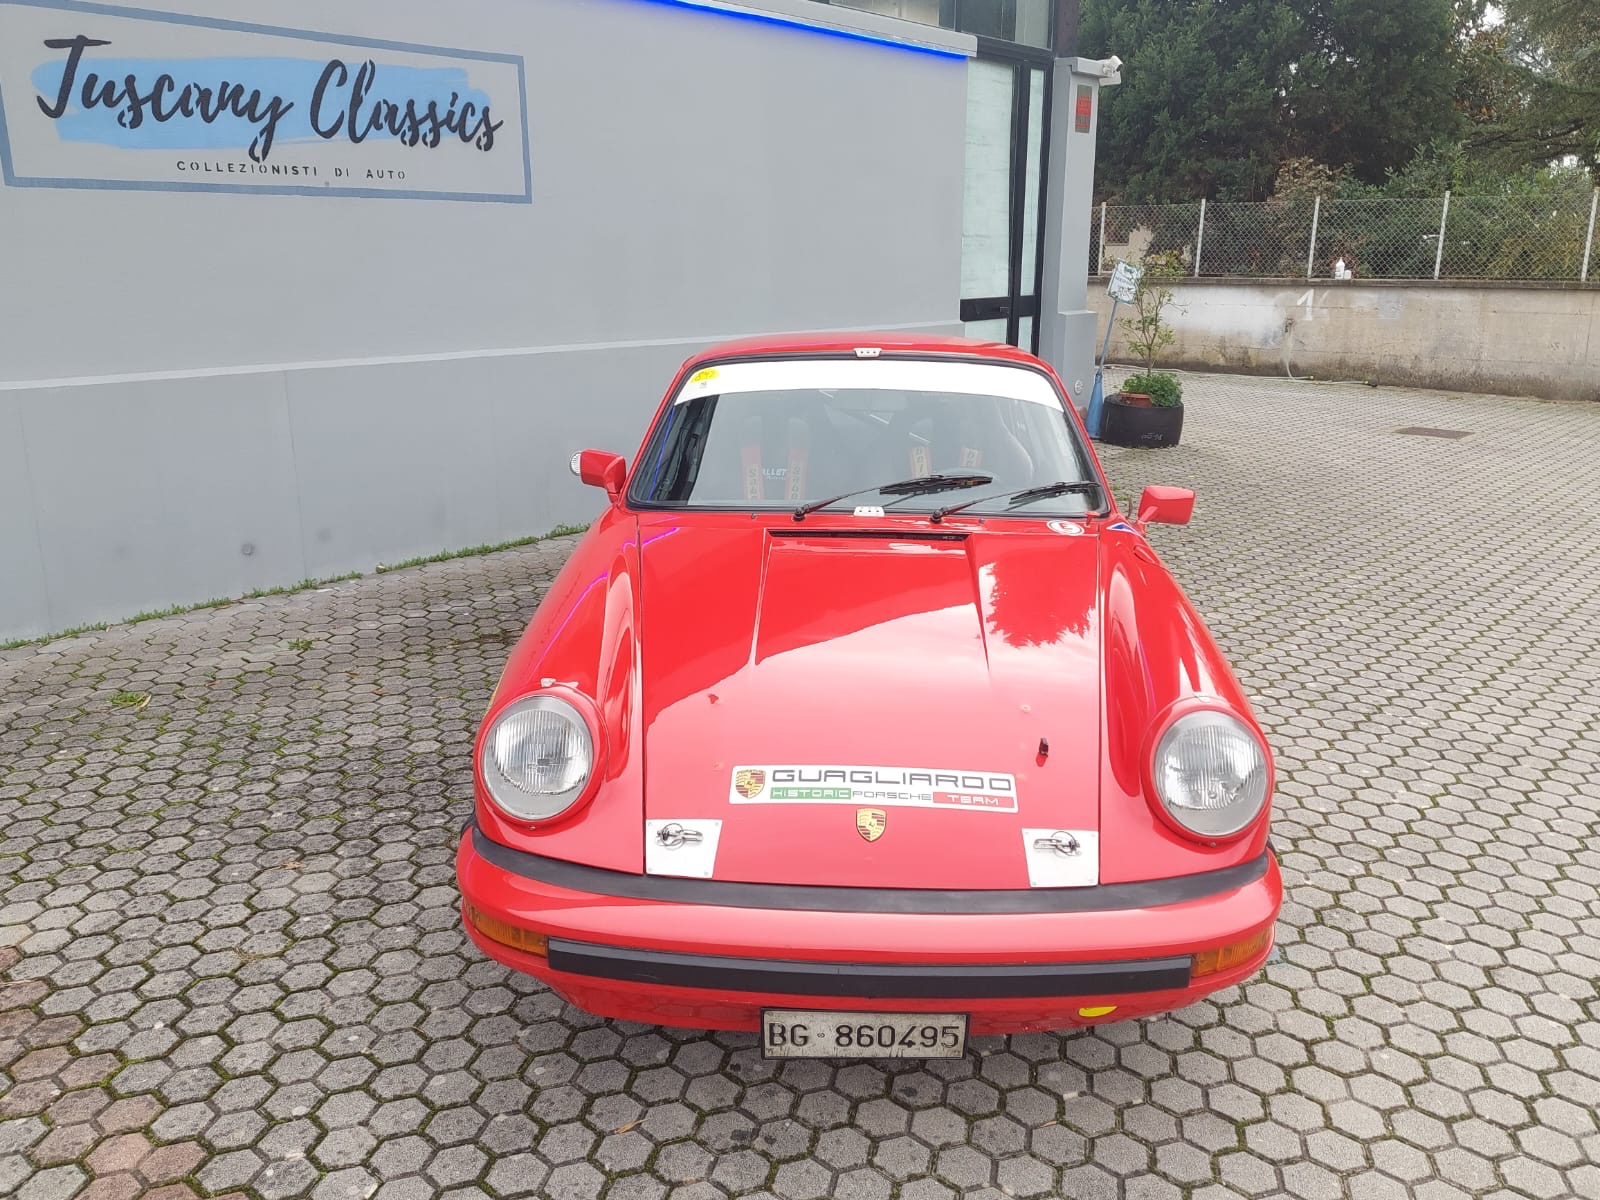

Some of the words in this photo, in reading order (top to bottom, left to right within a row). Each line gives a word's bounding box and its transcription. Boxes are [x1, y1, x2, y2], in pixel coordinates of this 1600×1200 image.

[36, 34, 295, 163] Tuscany
[309, 58, 504, 152] Classics
[176, 160, 318, 177] COLLEZIONISTI
[334, 167, 349, 177] DI
[366, 168, 406, 180] AUTO
[771, 769, 1012, 791] GUAGLIARDO
[772, 788, 850, 799] HISTORIC
[852, 790, 932, 801] PORSCHE
[946, 794, 999, 806] TEAM
[768, 1022, 809, 1047] BG
[834, 1024, 960, 1048] 860495
